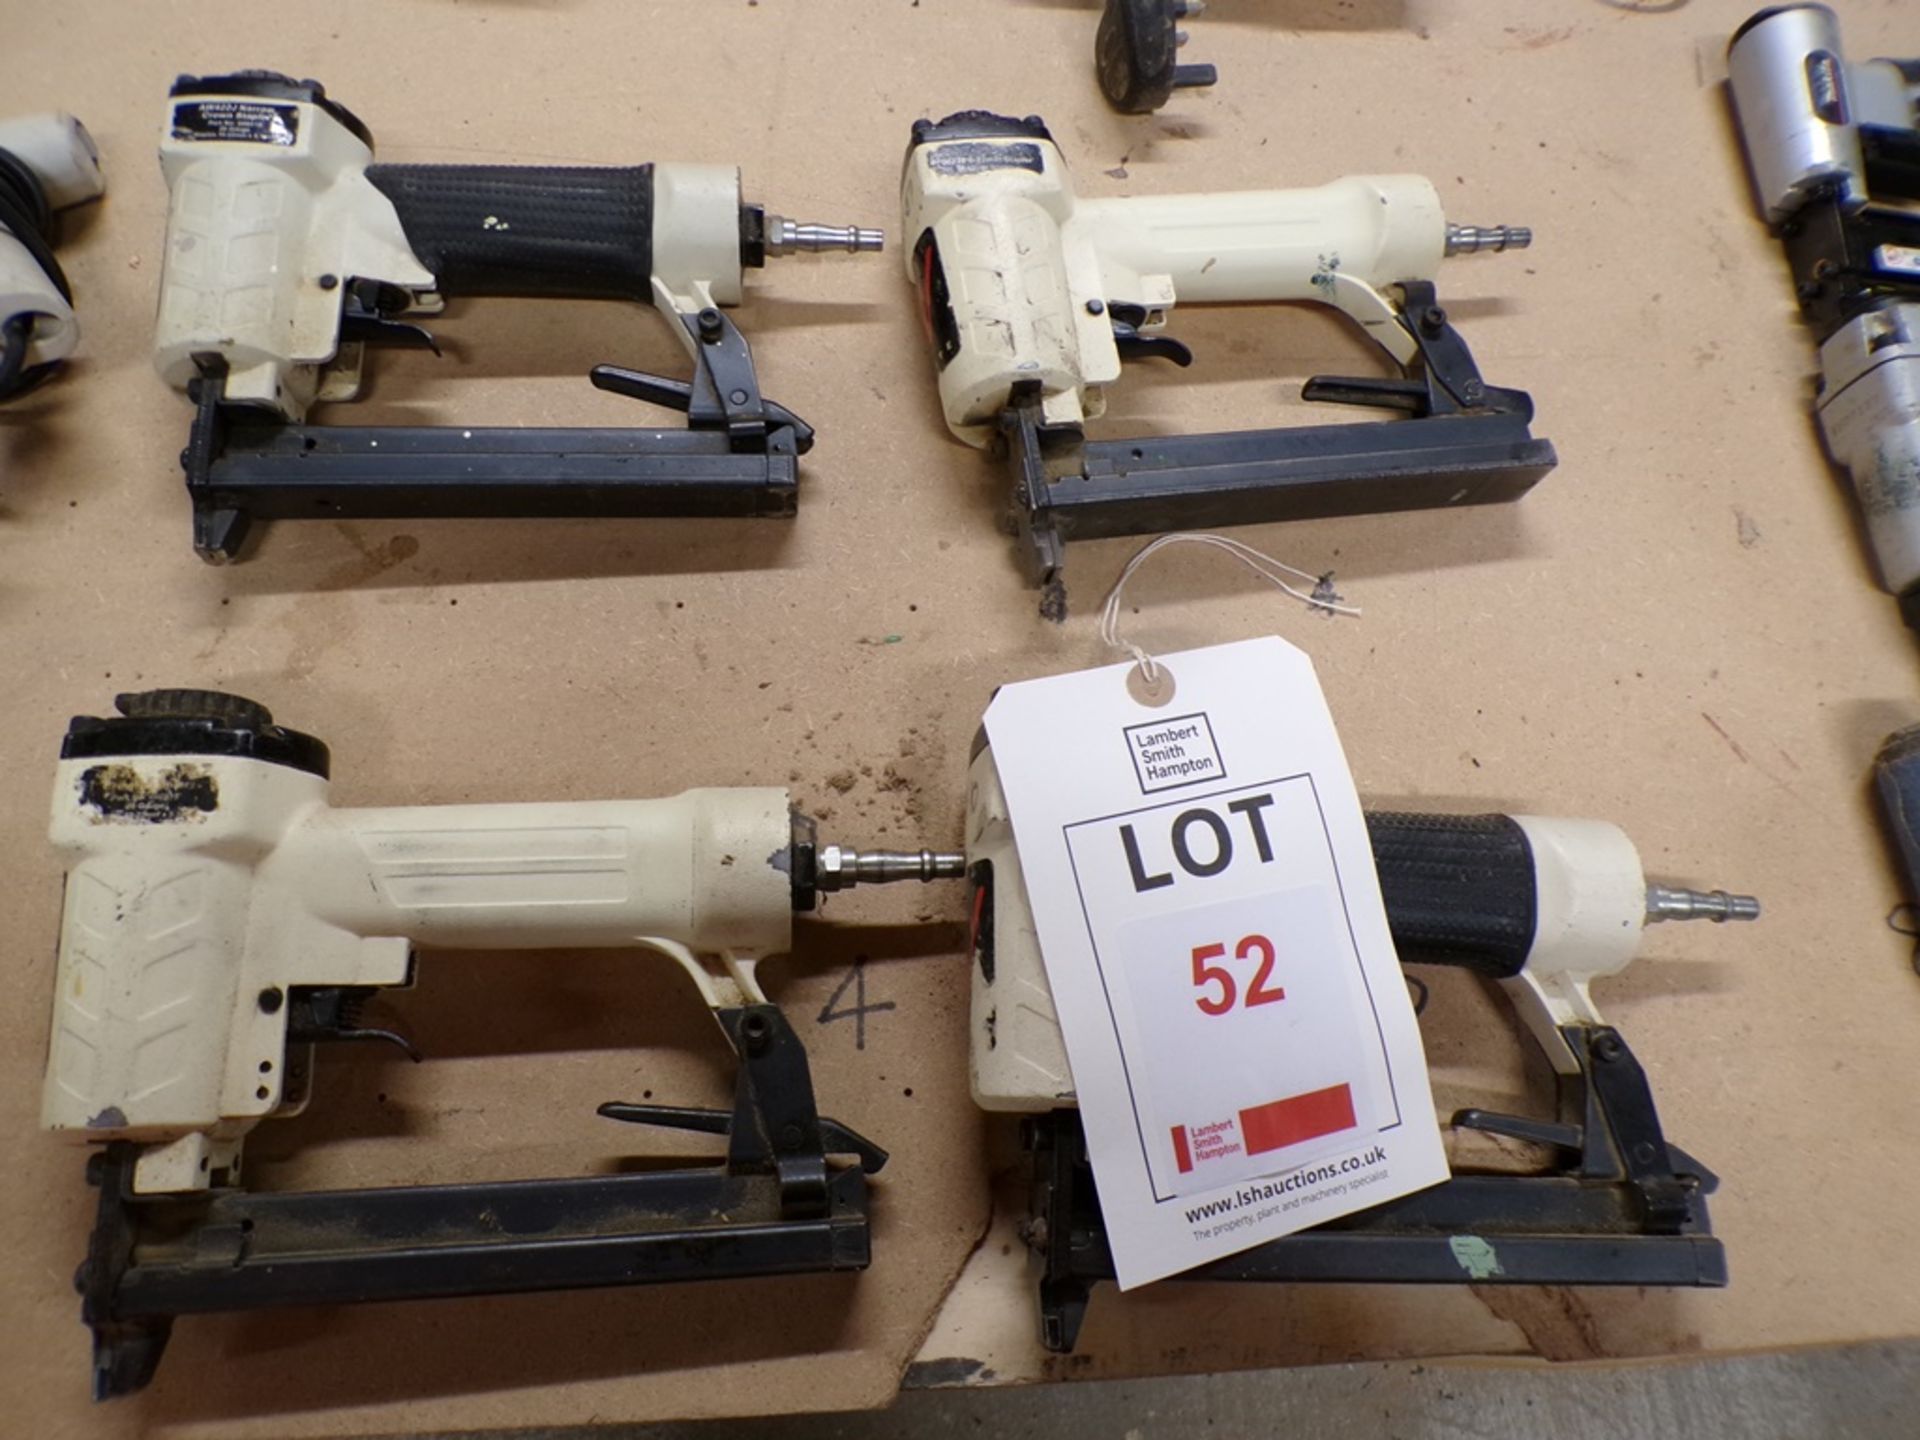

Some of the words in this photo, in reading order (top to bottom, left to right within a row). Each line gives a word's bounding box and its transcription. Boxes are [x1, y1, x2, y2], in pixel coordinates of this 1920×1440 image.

[1136, 725, 1199, 748] Lambert
[1142, 744, 1186, 764] Smith
[1146, 757, 1214, 780] Hampton
[1119, 793, 1275, 893] LOT
[1191, 934, 1286, 1017] 52
[816, 956, 896, 1051] 4
[1190, 1119, 1234, 1138] Lambert
[1193, 1134, 1224, 1150] Smith
[1195, 1142, 1241, 1162] Hampton
[1185, 1145, 1388, 1225] www.lshauctions.co.uk
[1193, 1229, 1212, 1241] The
[1256, 1204, 1281, 1221] plant
[1281, 1198, 1300, 1212] and
[1301, 1183, 1349, 1207] machinery
[1349, 1168, 1390, 1191] specialist
